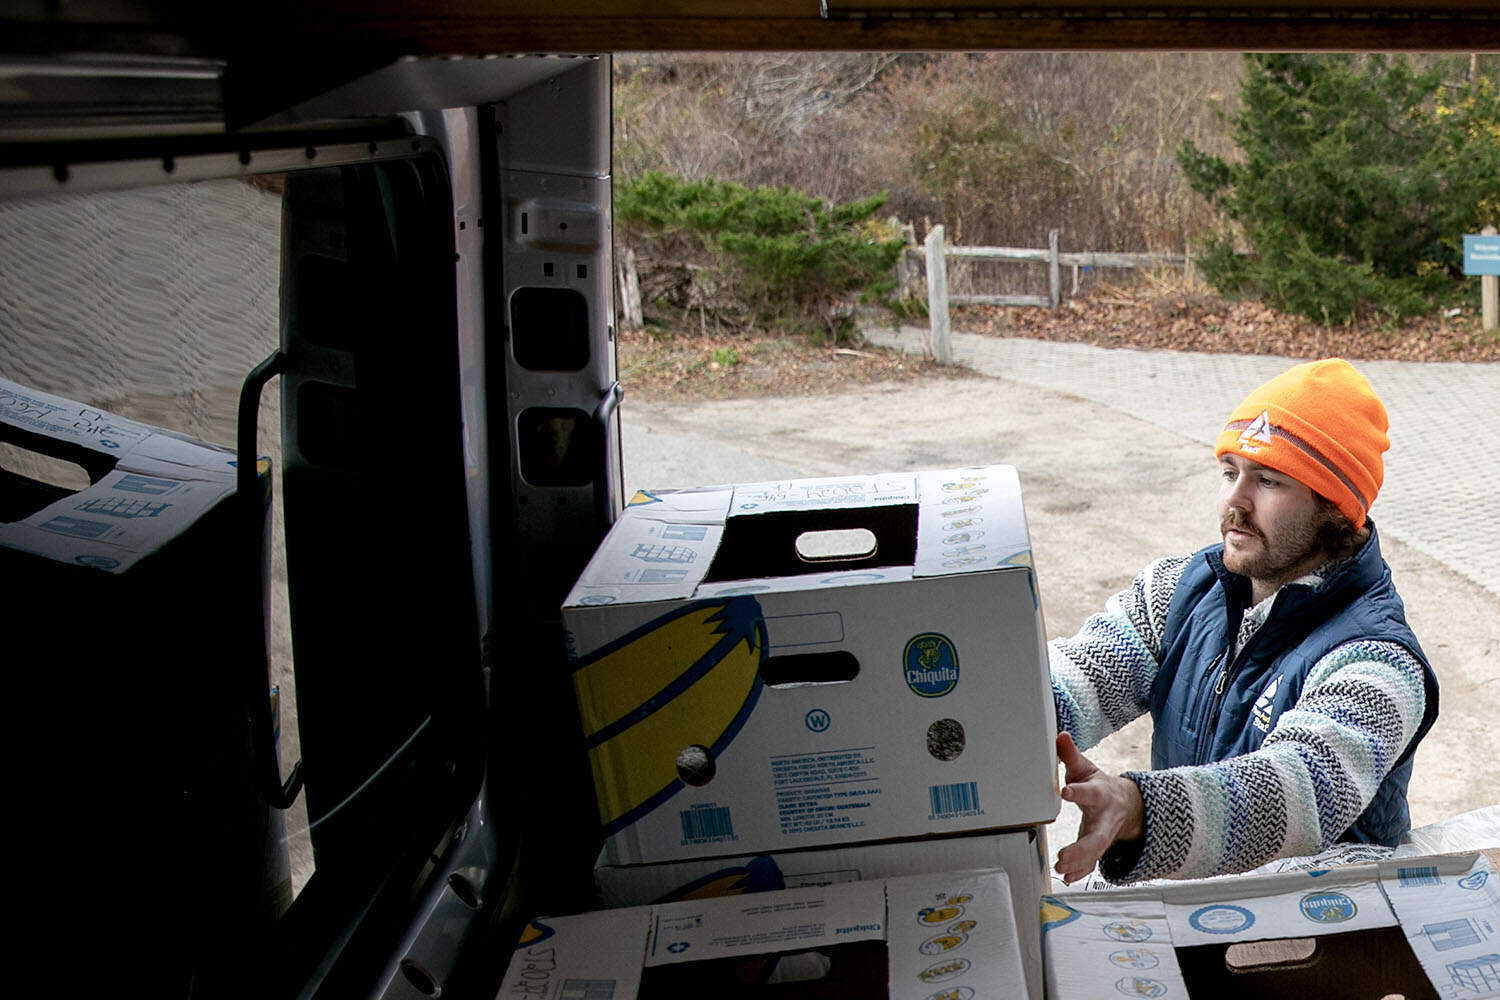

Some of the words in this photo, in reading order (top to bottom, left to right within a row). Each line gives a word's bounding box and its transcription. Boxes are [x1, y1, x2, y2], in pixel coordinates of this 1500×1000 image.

[906, 664, 959, 686] Chiquita
[1302, 897, 1353, 910] Chiquita
[836, 923, 882, 936] Chiquita
